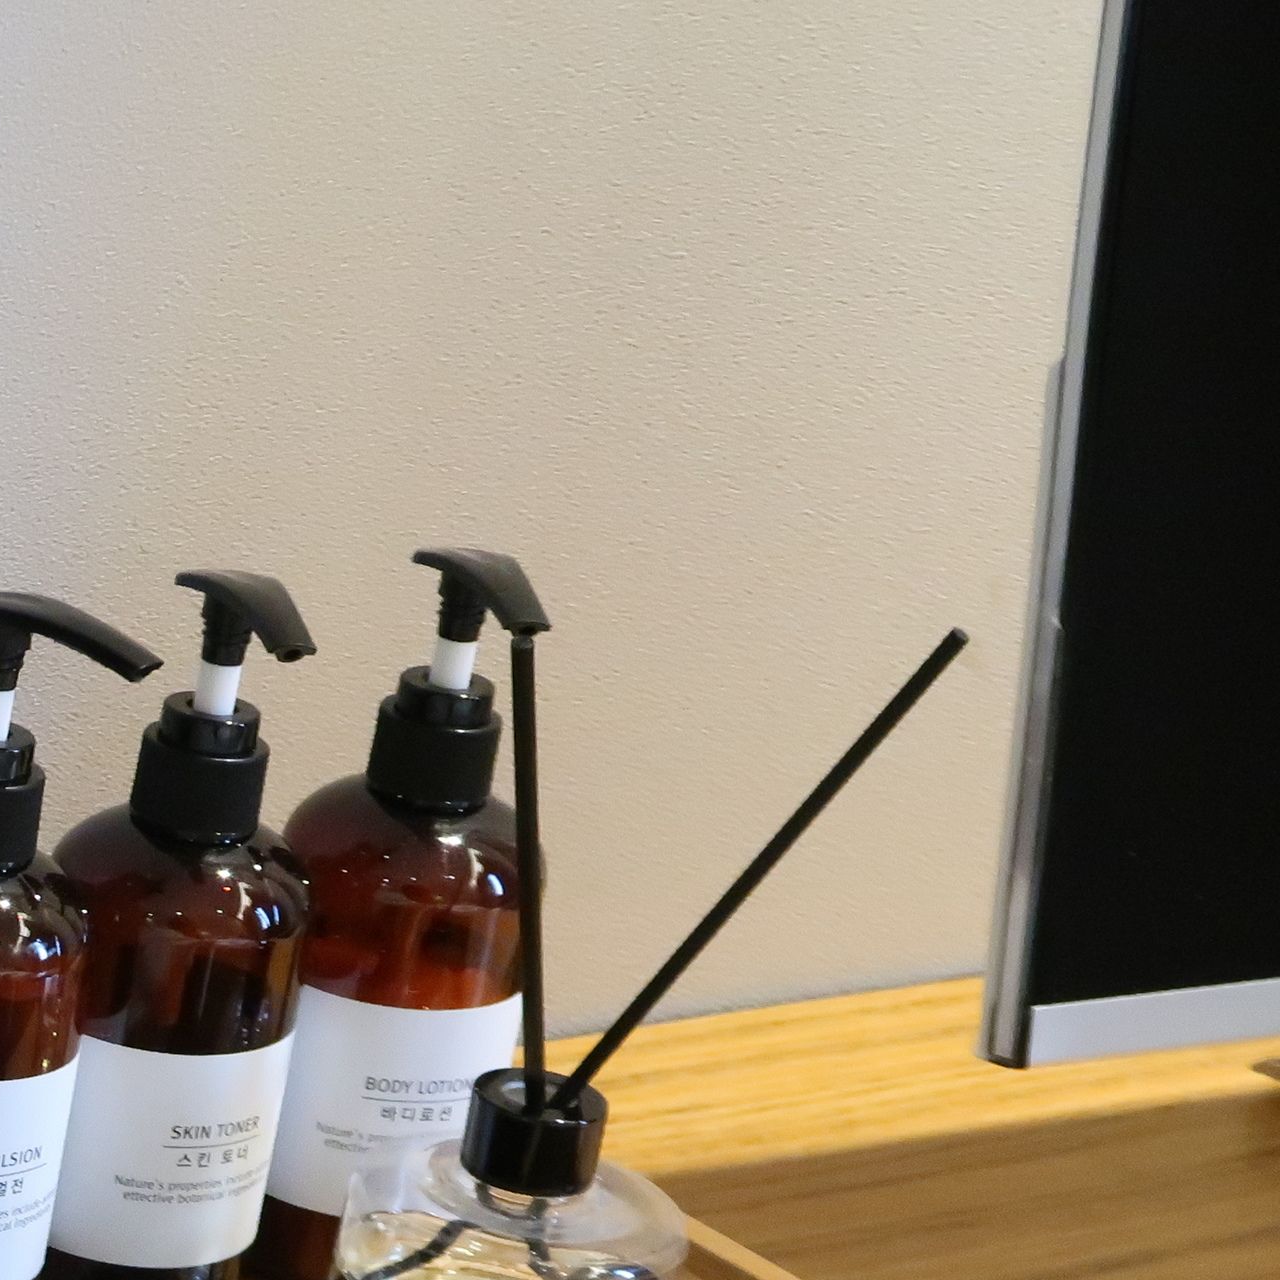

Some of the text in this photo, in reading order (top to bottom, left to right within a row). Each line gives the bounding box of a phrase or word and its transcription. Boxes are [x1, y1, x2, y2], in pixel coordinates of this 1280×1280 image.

[364, 1075, 475, 1095] BODY LOTION
[170, 1115, 261, 1140] SKIN TONER
